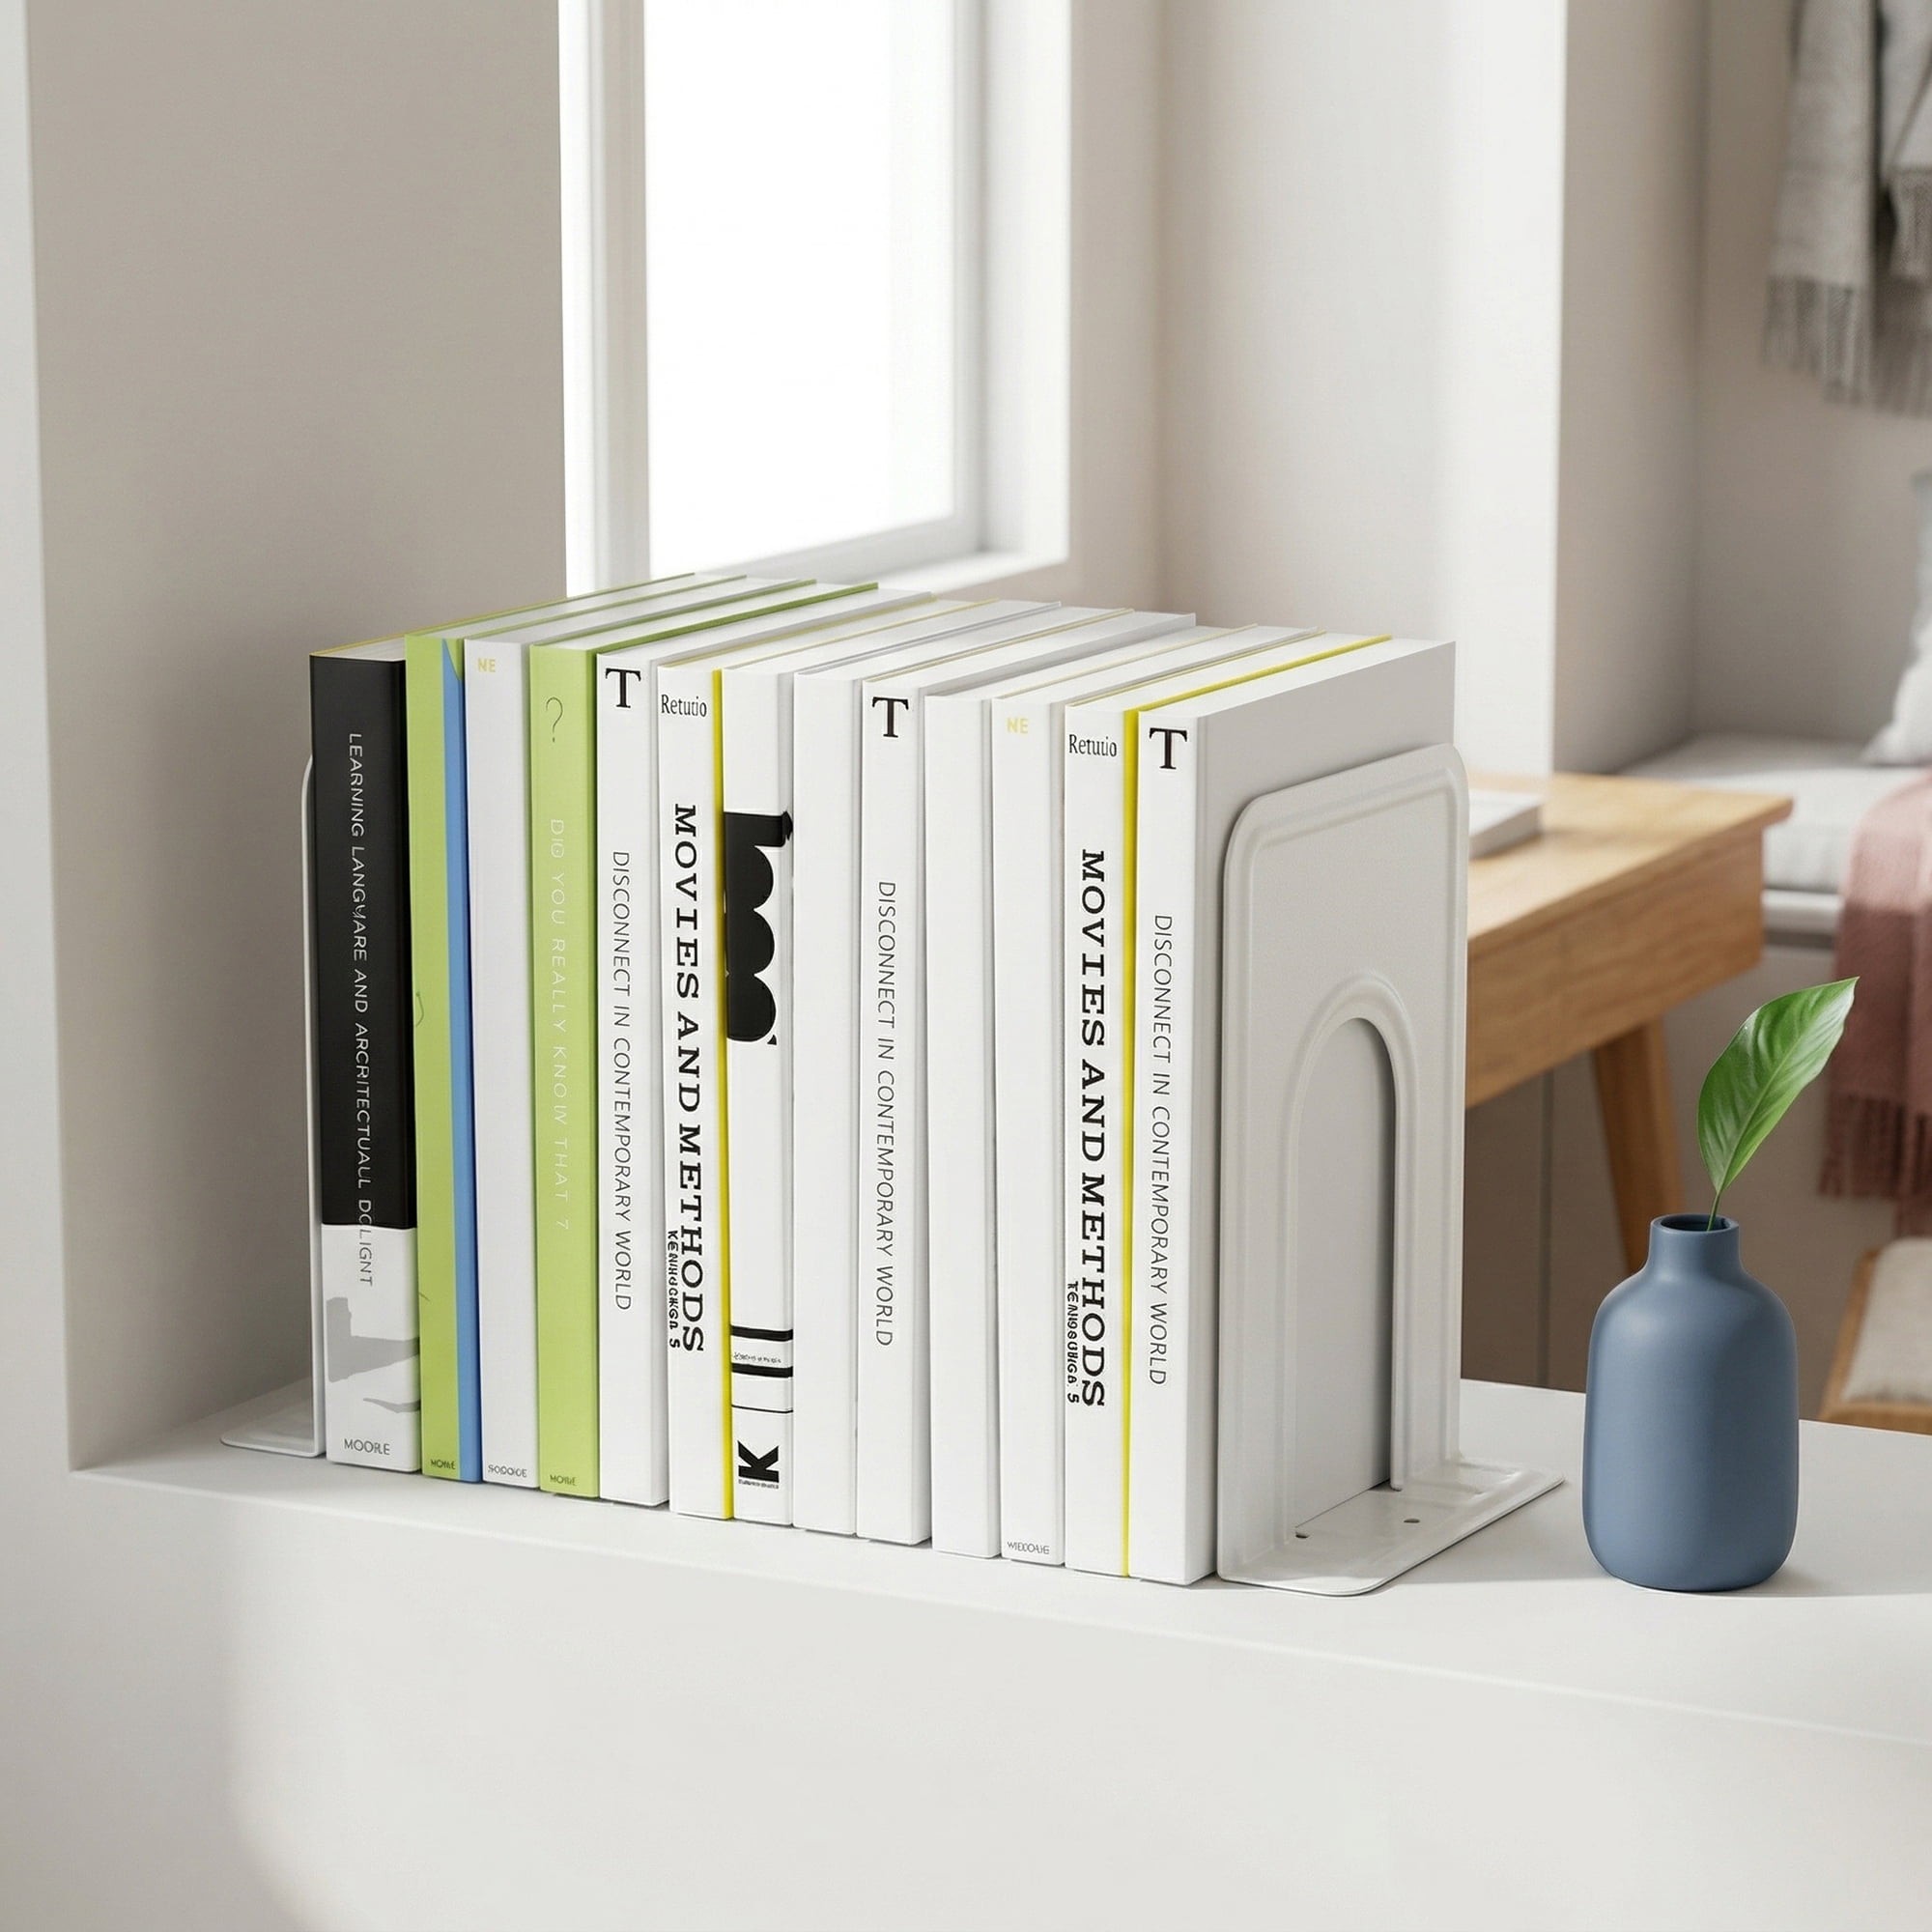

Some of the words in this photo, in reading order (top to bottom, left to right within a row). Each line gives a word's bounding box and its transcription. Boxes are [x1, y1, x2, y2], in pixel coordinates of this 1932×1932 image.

[477, 658, 497, 672] NE
[605, 668, 641, 708] T
[871, 696, 909, 738] T
[1006, 717, 1029, 734] NE
[1149, 727, 1188, 770] T
[349, 733, 365, 838] LEARNING
[549, 872, 565, 924] YOU
[611, 850, 631, 997] DISCONNECT
[674, 803, 701, 999] MOVIES
[552, 938, 567, 1033] REALLY
[877, 881, 896, 1030] DISCONNECT
[1081, 848, 1106, 1047] MOVIES
[354, 968, 369, 1013] AND
[613, 1005, 631, 1028] IN
[1152, 915, 1173, 1065] DISCONNECT
[677, 1011, 702, 1113] AND
[877, 1037, 895, 1061] IN
[1151, 1072, 1171, 1095] IN
[613, 1037, 632, 1222] CONTEMPORARY
[1081, 1059, 1106, 1162] AND
[554, 1137, 569, 1203] THAT
[875, 1069, 895, 1257] CONTEMPORARY
[1150, 1105, 1171, 1294] CONTEMPORARY
[614, 1230, 632, 1311] WORLD
[679, 1122, 704, 1352] METHODS
[875, 1265, 894, 1347] WORLD
[1081, 1172, 1106, 1406] METHODS
[1149, 1302, 1168, 1385] WORLD
[737, 1440, 780, 1484] K
